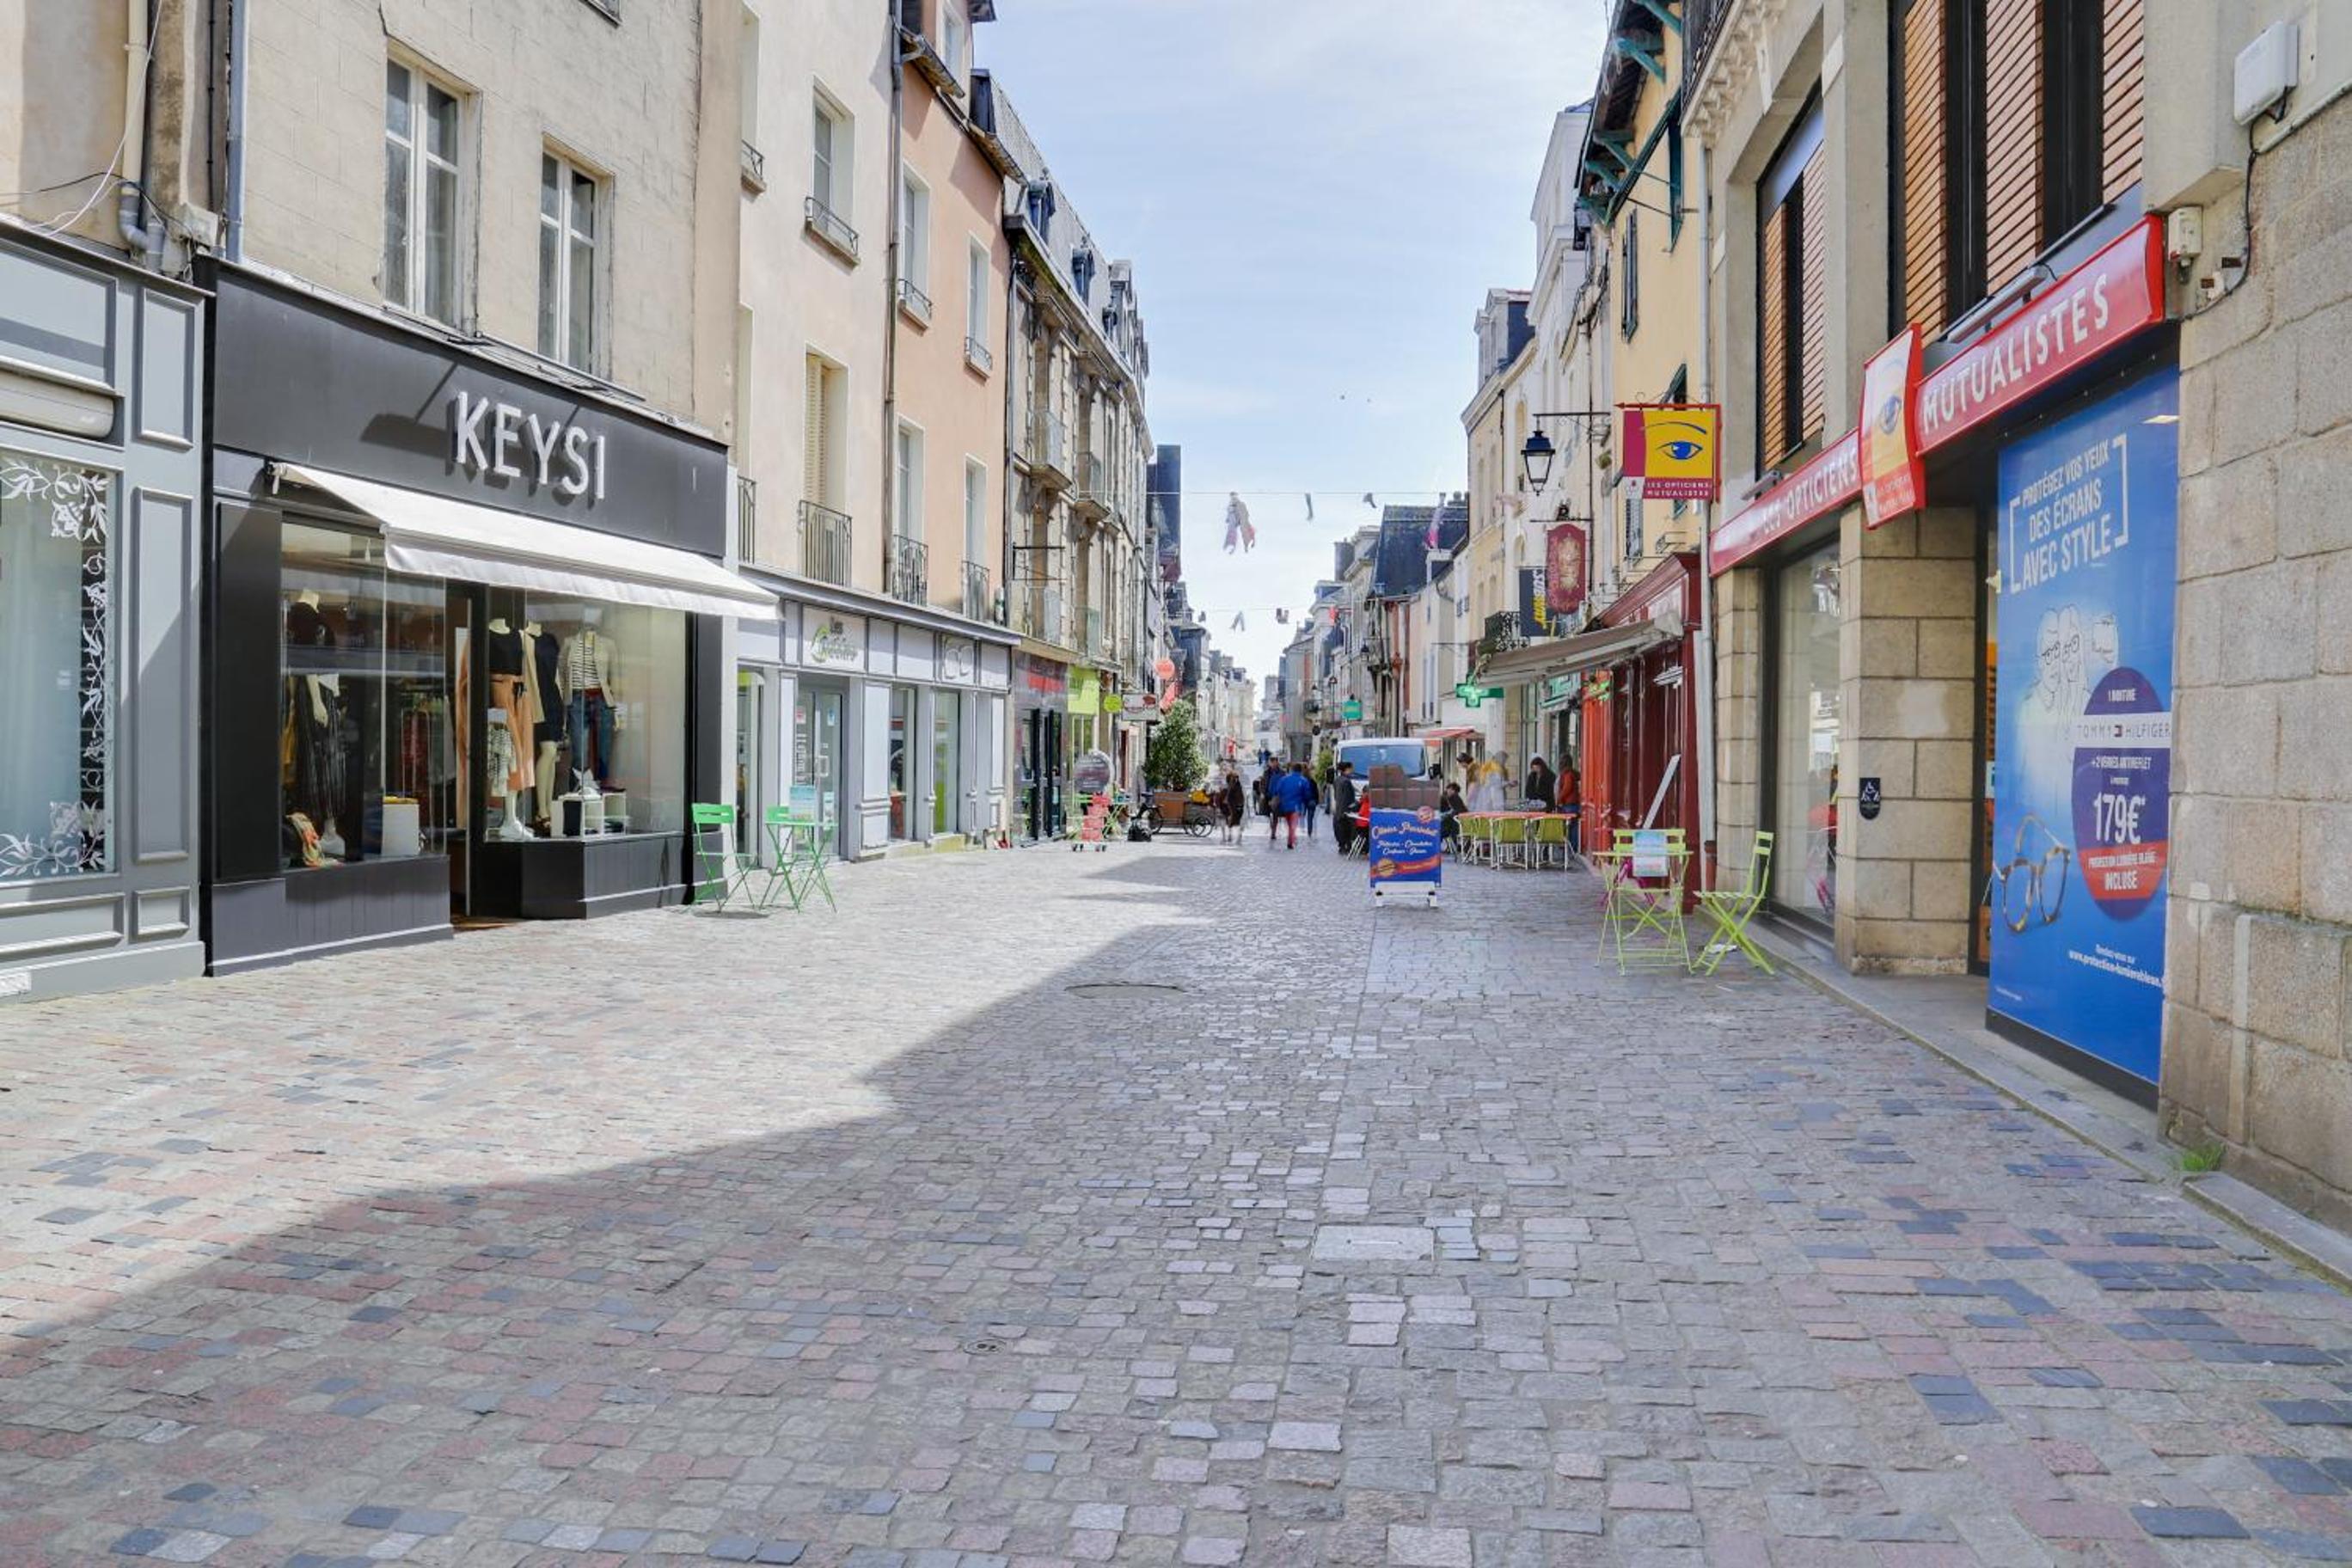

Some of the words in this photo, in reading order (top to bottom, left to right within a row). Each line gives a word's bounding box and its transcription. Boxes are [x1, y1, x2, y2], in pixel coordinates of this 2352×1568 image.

[1923, 273, 2109, 433] MUTUALISTES
[456, 391, 605, 499] KEYSI
[1787, 446, 1859, 519] OPTICIENS
[2065, 457, 2083, 486] VOS
[2084, 439, 2110, 470] YEUX
[2029, 508, 2051, 542] DES
[2054, 478, 2103, 530] ÉCRANS
[2022, 539, 2058, 590] AVEC
[2061, 513, 2111, 571] STYLE
